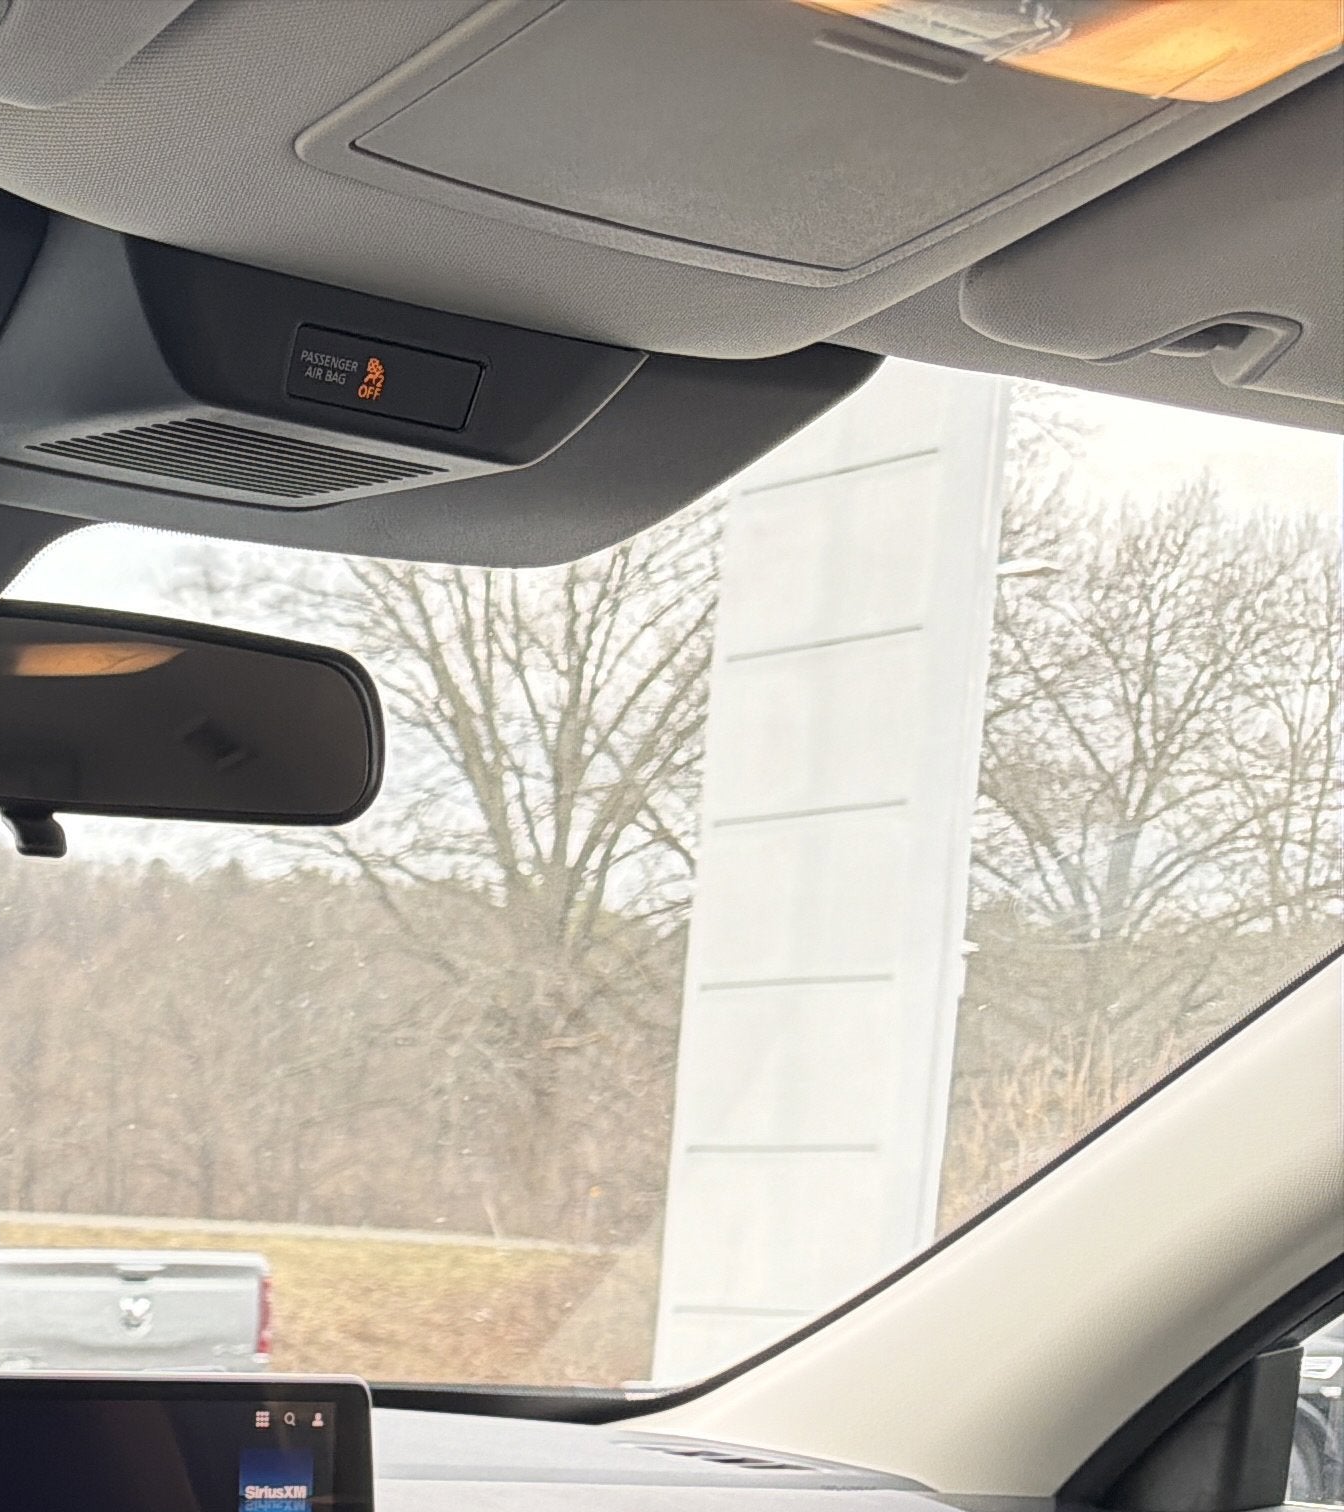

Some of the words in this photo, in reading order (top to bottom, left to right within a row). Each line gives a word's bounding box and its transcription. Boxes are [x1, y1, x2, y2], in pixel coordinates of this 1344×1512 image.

[300, 350, 359, 372] PASSENGER
[304, 368, 322, 381] AIR
[324, 371, 347, 385] BAG
[357, 385, 381, 401] OFF
[244, 1485, 307, 1500] SiriusXM
